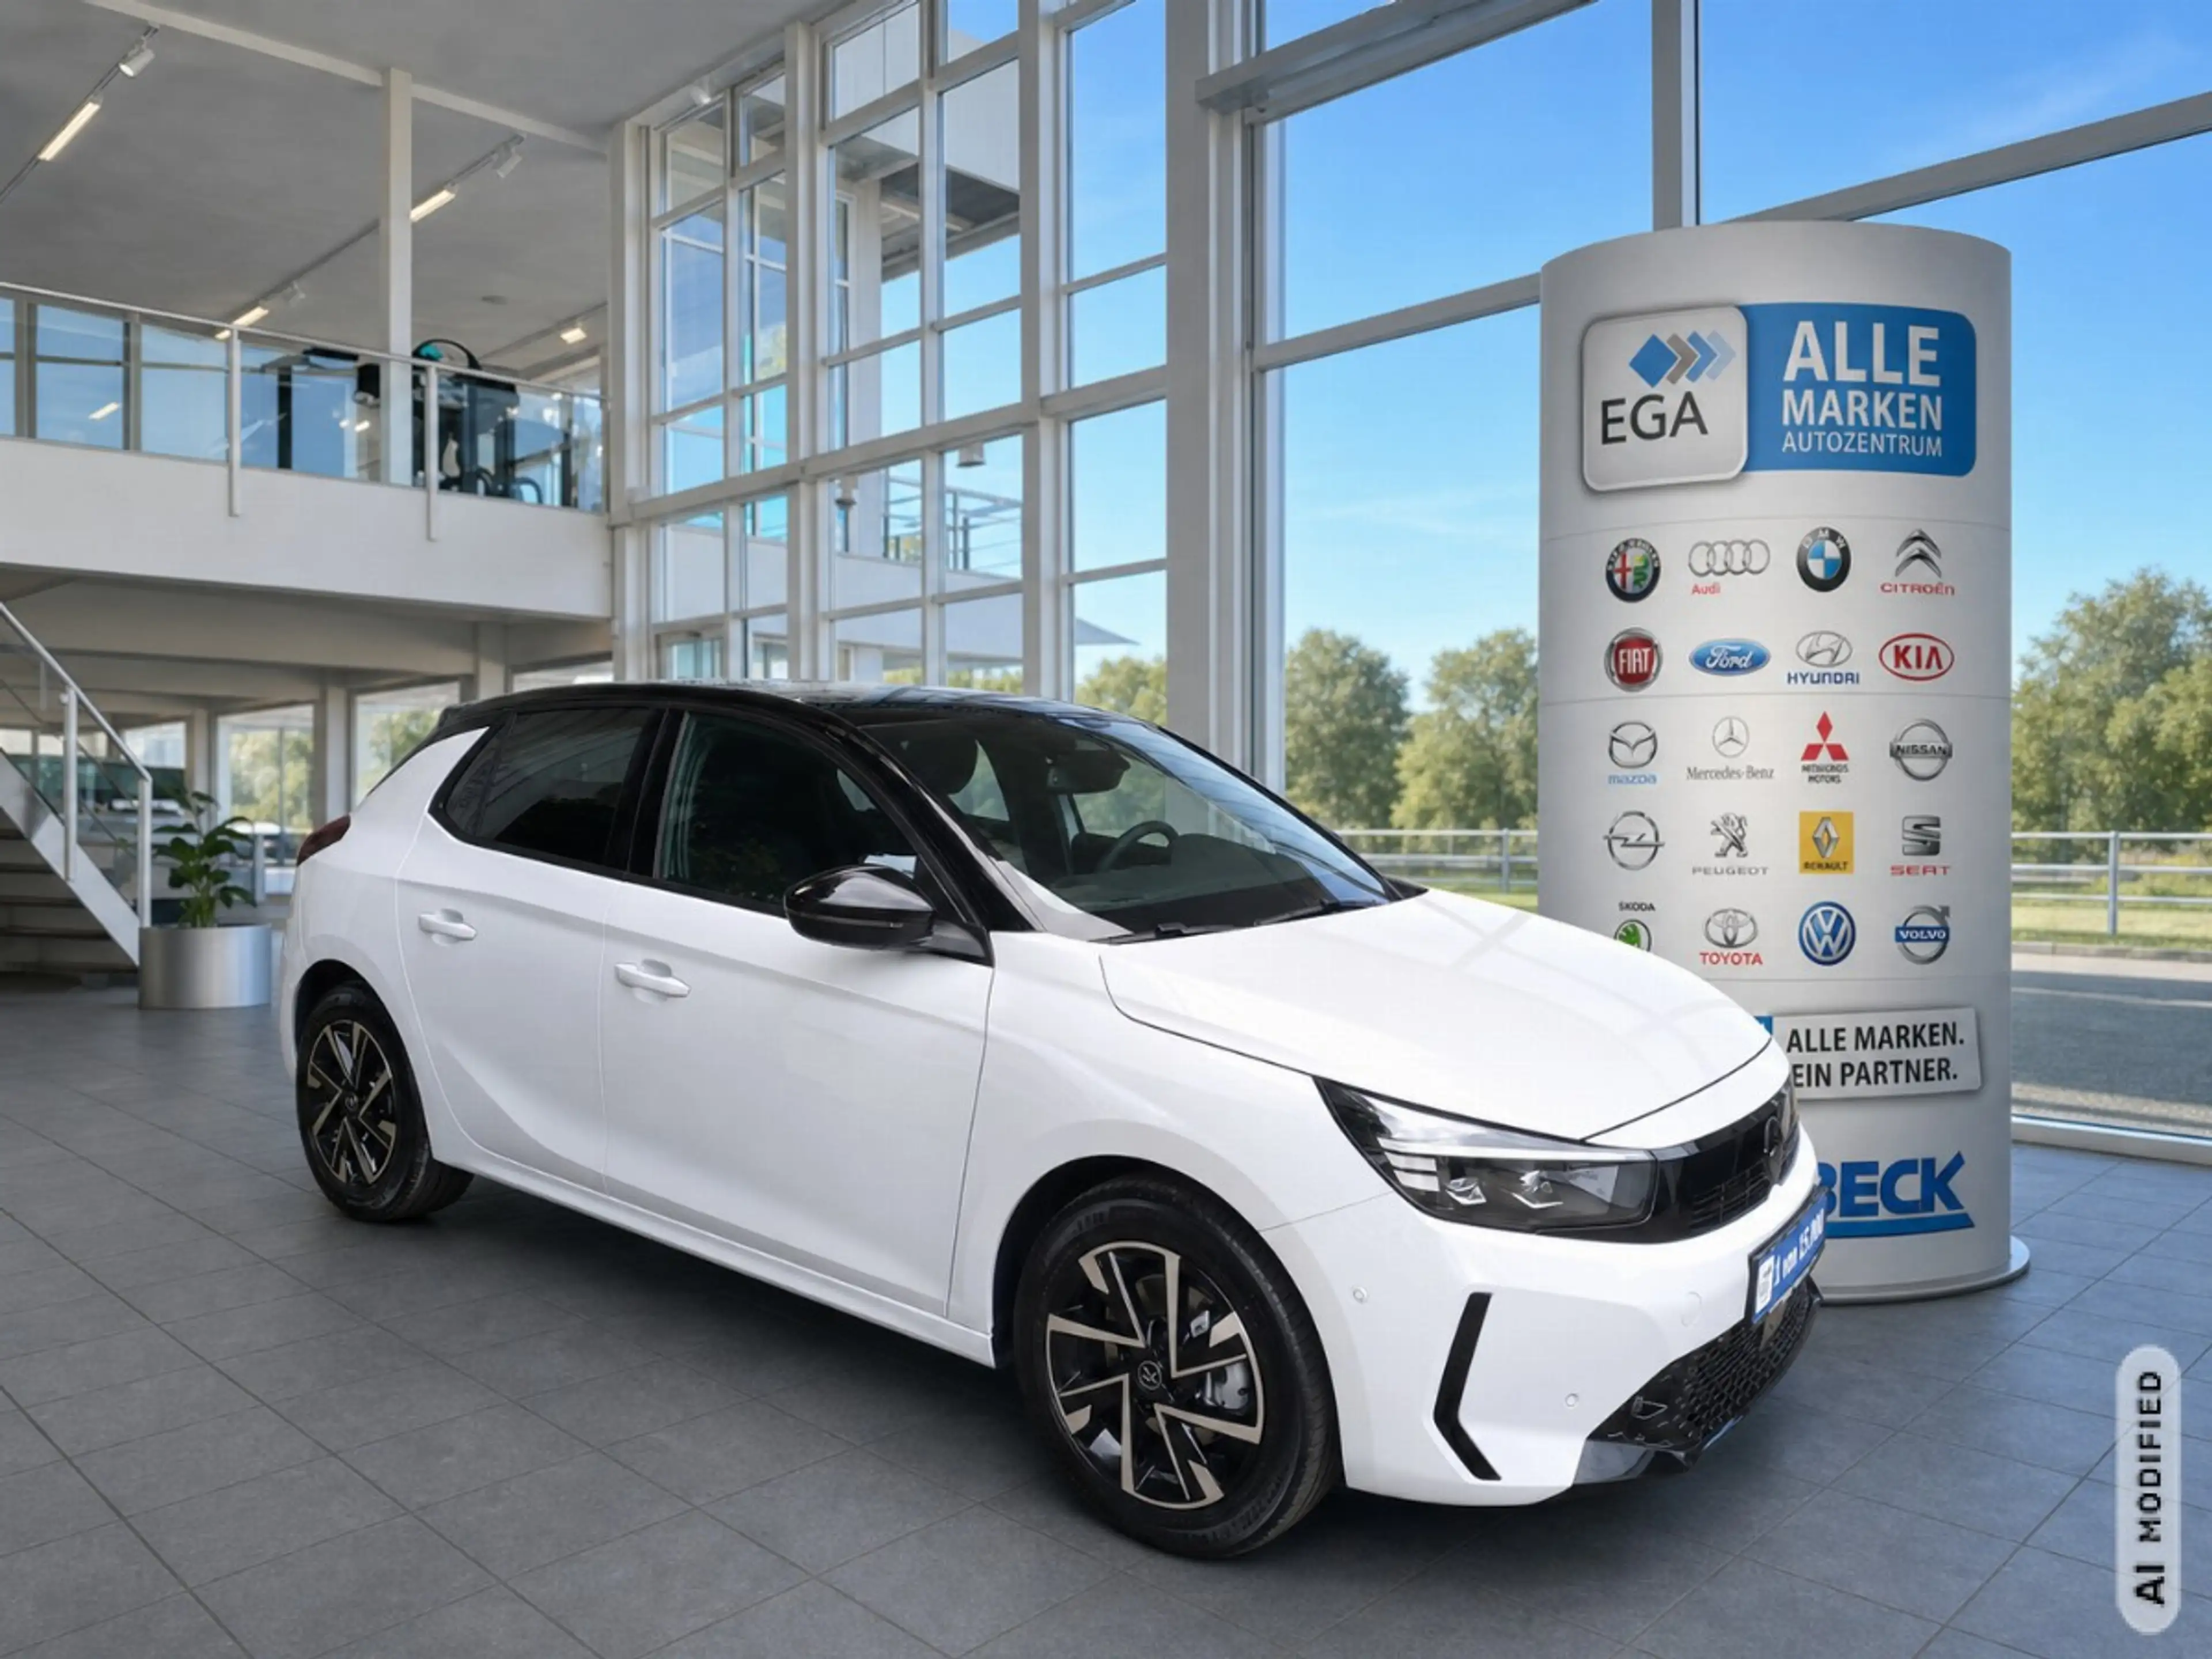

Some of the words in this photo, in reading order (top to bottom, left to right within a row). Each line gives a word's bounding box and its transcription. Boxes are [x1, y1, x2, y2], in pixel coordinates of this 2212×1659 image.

[1783, 320, 1941, 387] ALLE
[1601, 391, 1708, 445] EGA
[1782, 389, 1942, 431] MARKEN
[1782, 431, 1942, 457] AUTOZENTRUM
[1691, 582, 1721, 595] Audi
[1619, 647, 1651, 674] FIAT
[1706, 645, 1753, 668] Ford
[1893, 644, 1944, 670] KIA
[1896, 744, 1947, 755] NISSAN
[1608, 774, 1657, 785] mazda
[1686, 766, 1774, 781] Mercedes-Benz
[1691, 866, 1768, 876] PEUGEOT
[1890, 865, 1951, 876] SEAT
[1899, 929, 1946, 940] VOLVO
[1699, 952, 1763, 966] TOYOTA
[1786, 1027, 1847, 1053] ALLE
[1854, 1021, 1965, 1051] MARKEN.
[1792, 1063, 1832, 1089] EIN
[1840, 1058, 1958, 1086] PARTNER.
